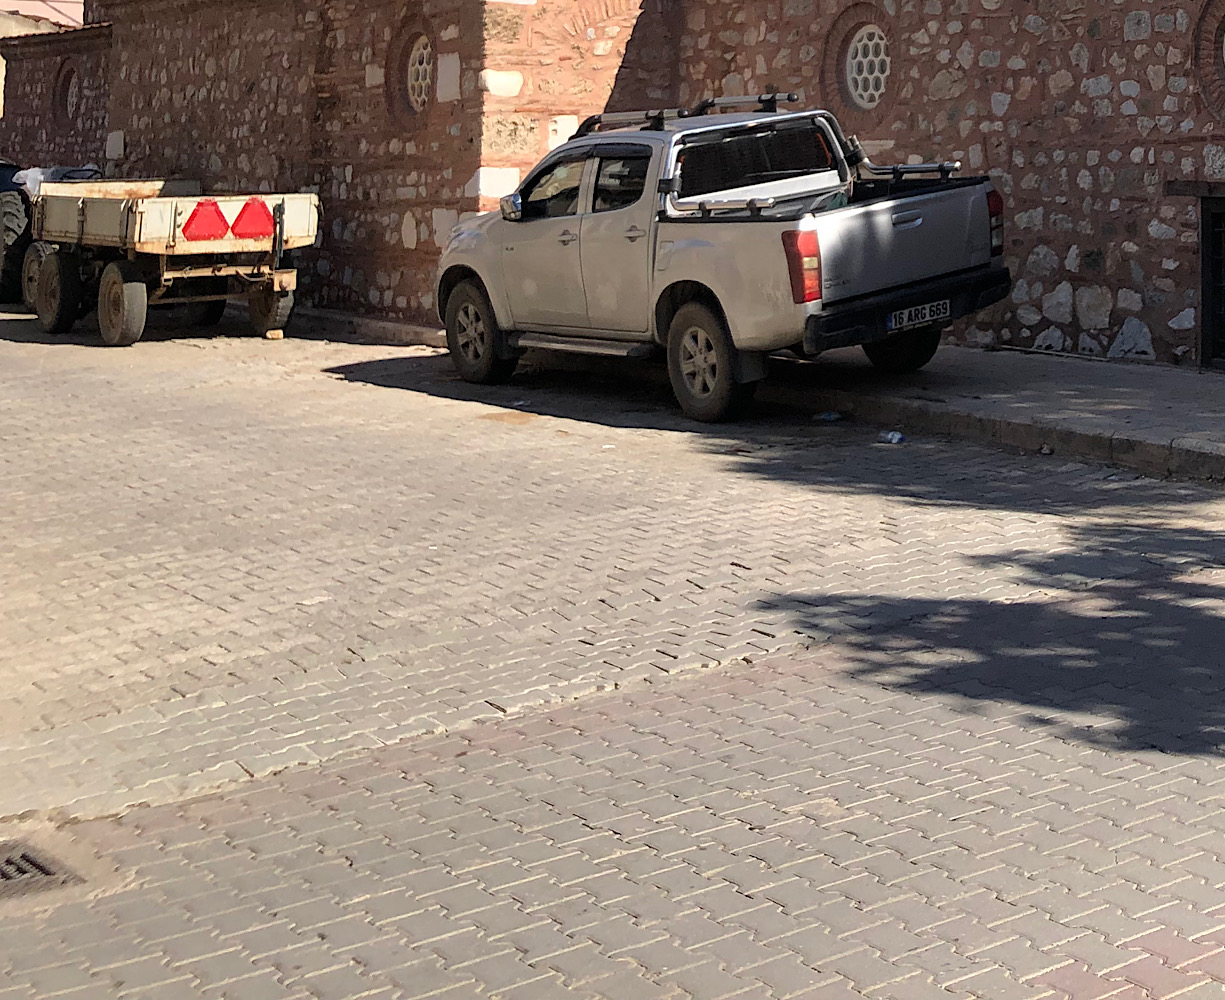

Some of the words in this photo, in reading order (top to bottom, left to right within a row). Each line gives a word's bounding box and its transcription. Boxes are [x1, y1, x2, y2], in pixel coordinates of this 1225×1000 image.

[893, 312, 904, 327] 16
[907, 306, 926, 323] ARG
[929, 301, 948, 318] 669
